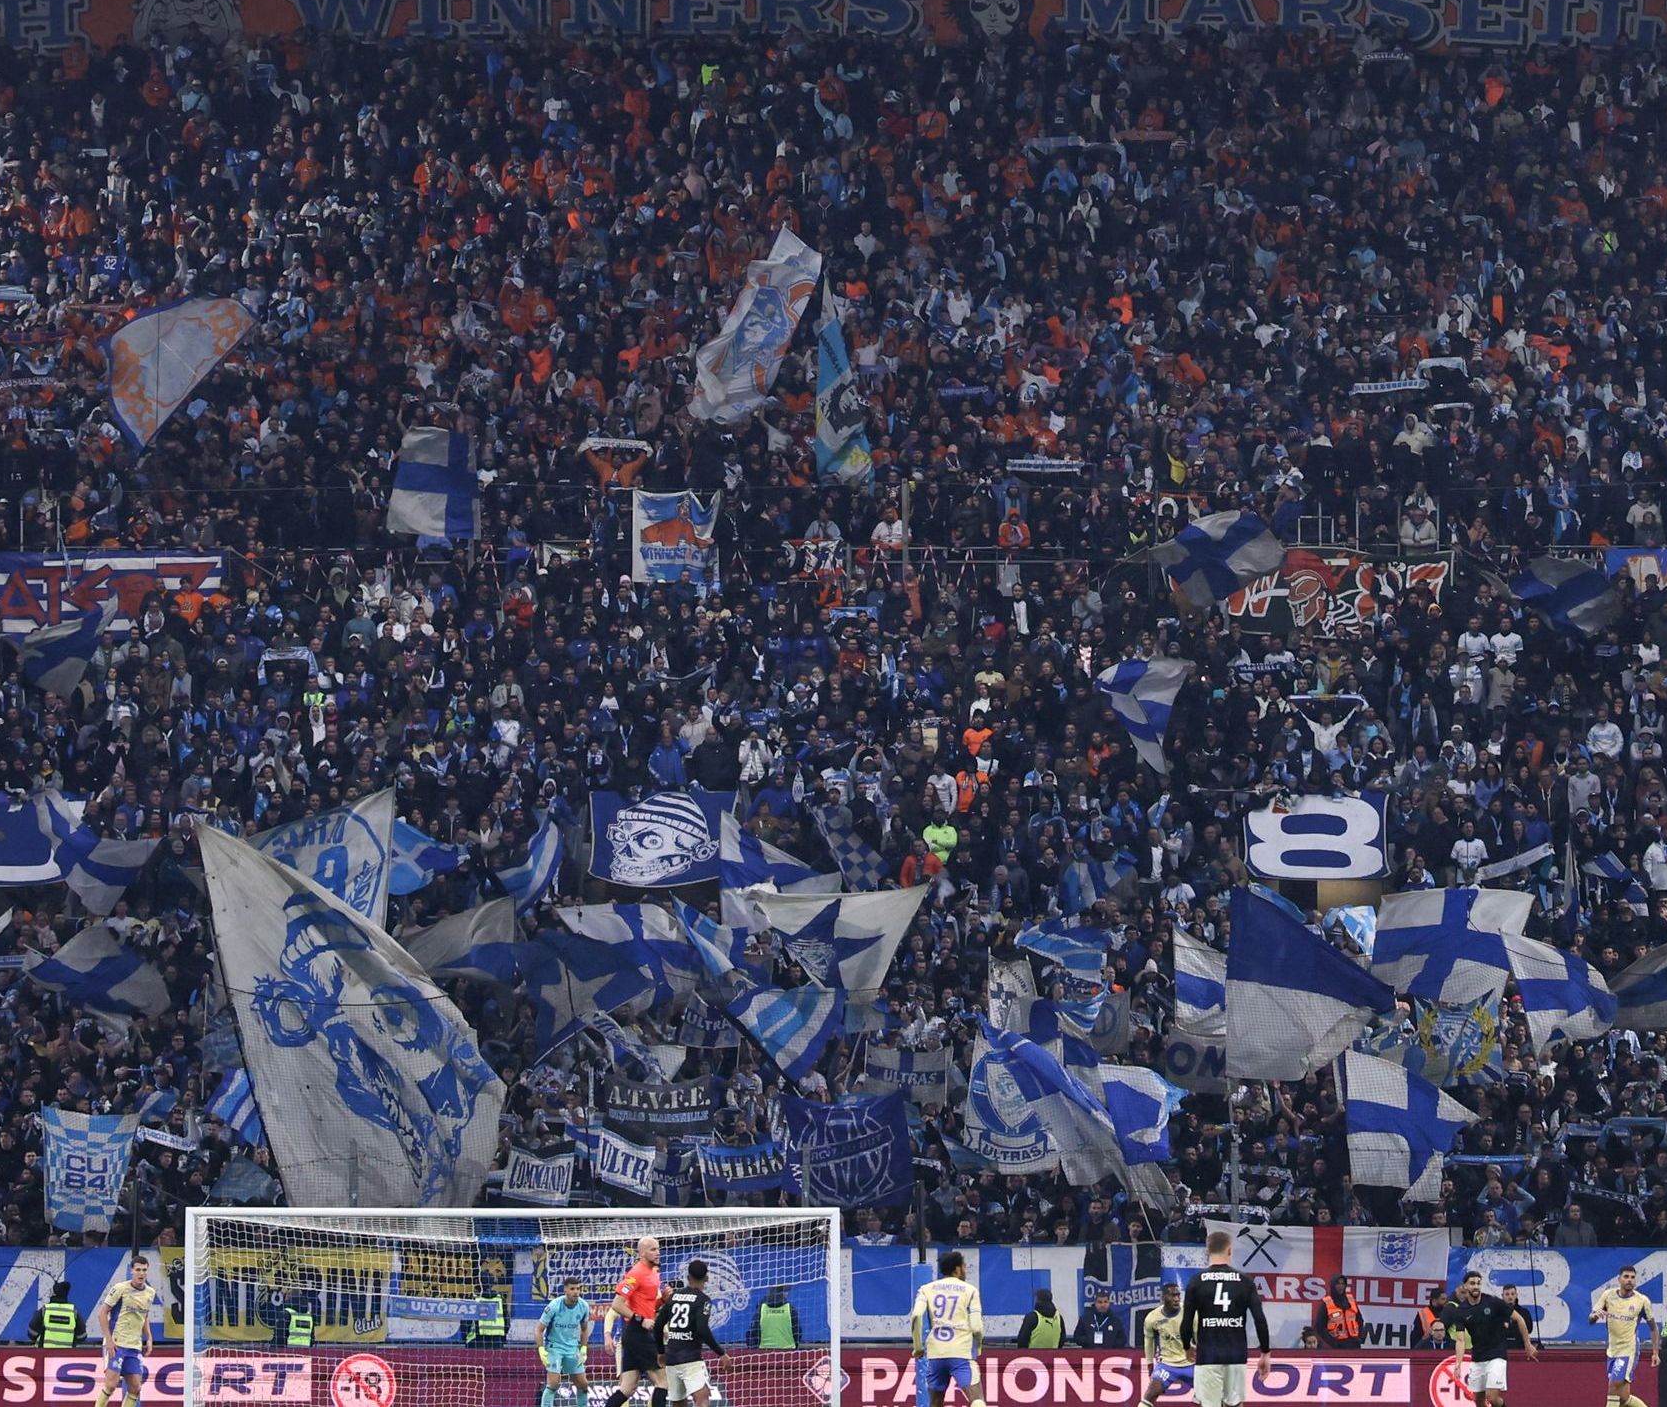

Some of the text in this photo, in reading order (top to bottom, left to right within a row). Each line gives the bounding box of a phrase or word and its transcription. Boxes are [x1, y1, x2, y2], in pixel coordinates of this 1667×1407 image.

[1247, 794, 1384, 879] 8
[883, 1068, 938, 1086] ULTRAS
[66, 1153, 109, 1174] CU
[981, 1144, 1043, 1163] ULTRAS
[65, 1172, 107, 1191] 84
[509, 1155, 572, 1195] COMMANDO
[652, 1170, 693, 1187] MARSEILL
[1200, 1271, 1242, 1282] CRESSWELL
[1213, 1282, 1232, 1312] 4
[1252, 1275, 1439, 1306] ARSILLE
[670, 1303, 690, 1329] 23
[934, 1294, 960, 1320] 97
[353, 1314, 383, 1335] Club
[1202, 1316, 1244, 1328] newrest
[668, 1330, 694, 1341] ewrest
[52, 1362, 306, 1397] SORT
[861, 1356, 1133, 1403] PAIONS
